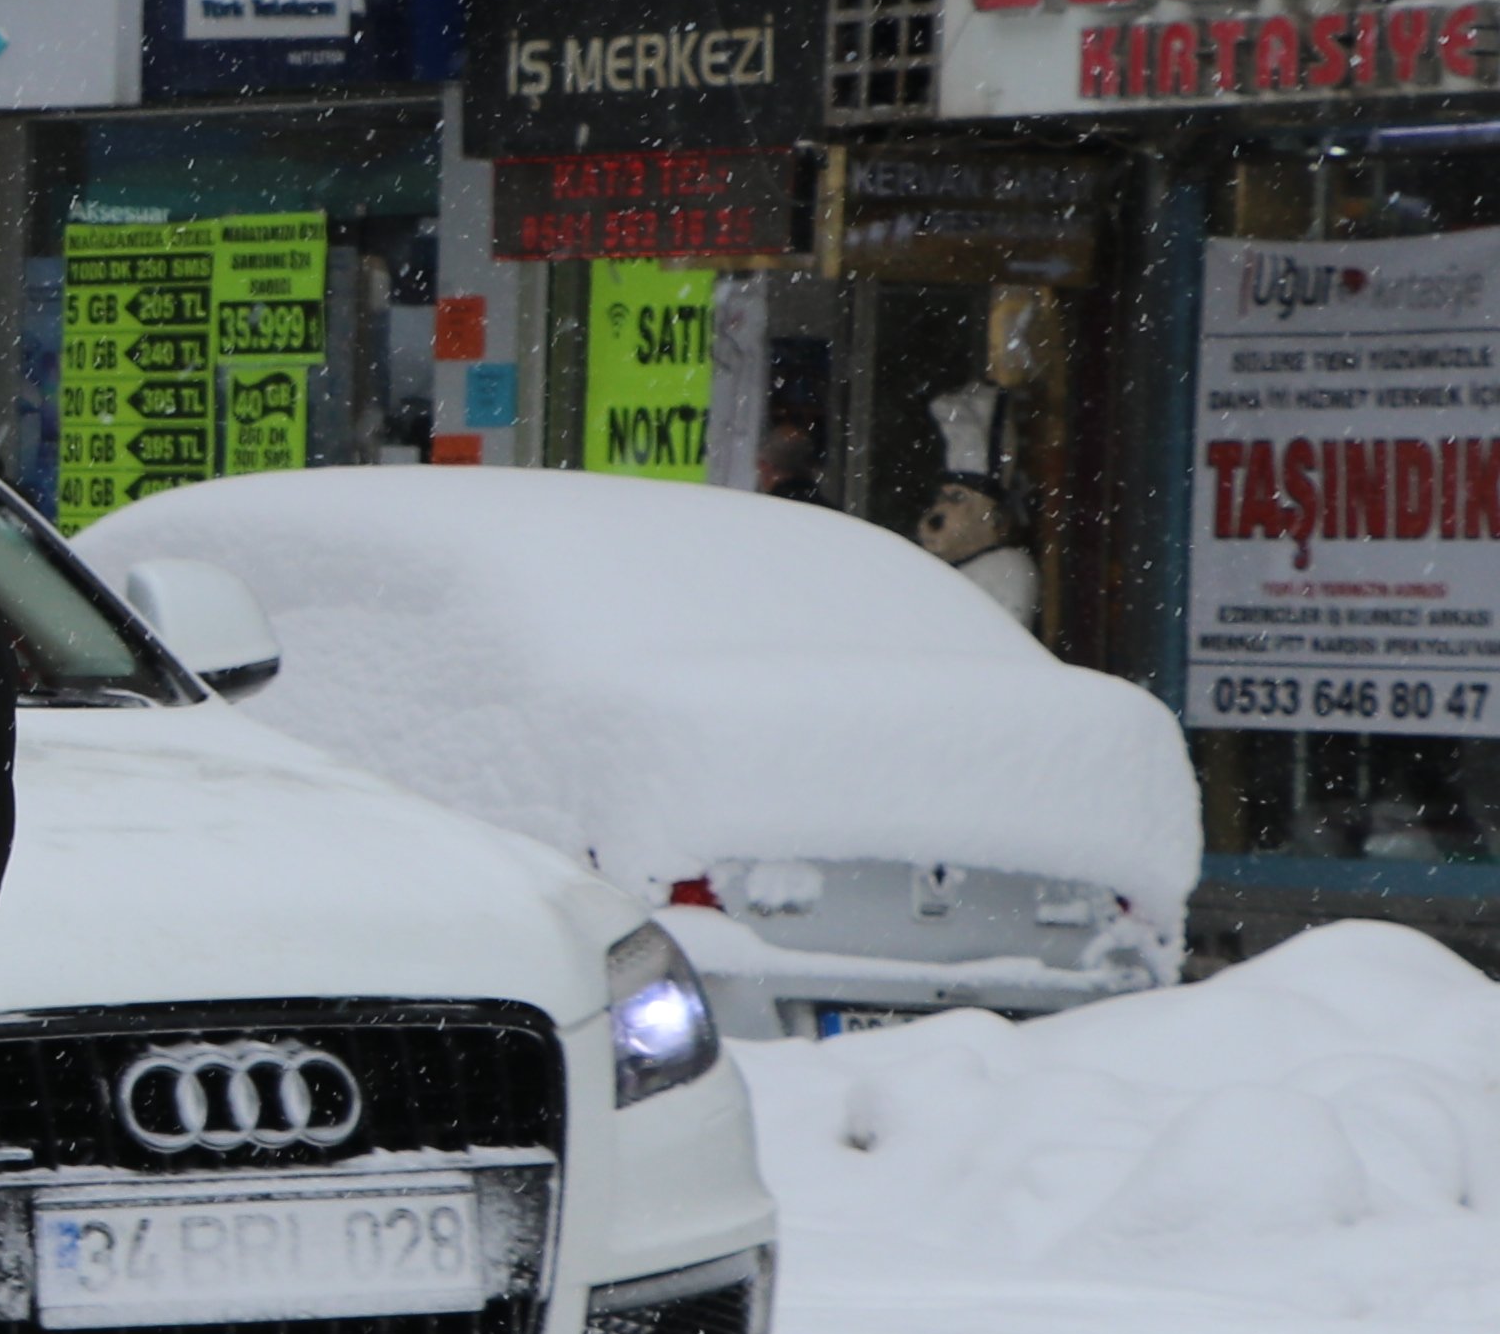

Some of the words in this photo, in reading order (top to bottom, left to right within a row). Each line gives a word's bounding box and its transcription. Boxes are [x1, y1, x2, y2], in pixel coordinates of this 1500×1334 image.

[507, 29, 552, 111] İŞ
[563, 13, 775, 95] MERKEZİ
[172, 256, 211, 278] SMS
[88, 294, 119, 325] GB
[181, 293, 207, 318] TL
[220, 304, 306, 350] 35.999
[92, 340, 118, 370] GB
[180, 340, 206, 365] TL
[91, 386, 118, 418] GB
[181, 387, 205, 413] TL
[90, 433, 115, 464] GB
[179, 433, 203, 459] TL
[89, 477, 115, 508] GB
[1207, 436, 1500, 570] TAŞINDIK
[1212, 675, 1301, 716] 0533
[1312, 679, 1378, 718] 646
[1390, 681, 1435, 719] 80
[1445, 682, 1491, 721] 47
[78, 1217, 165, 1292] 34
[346, 1205, 464, 1278] 028
